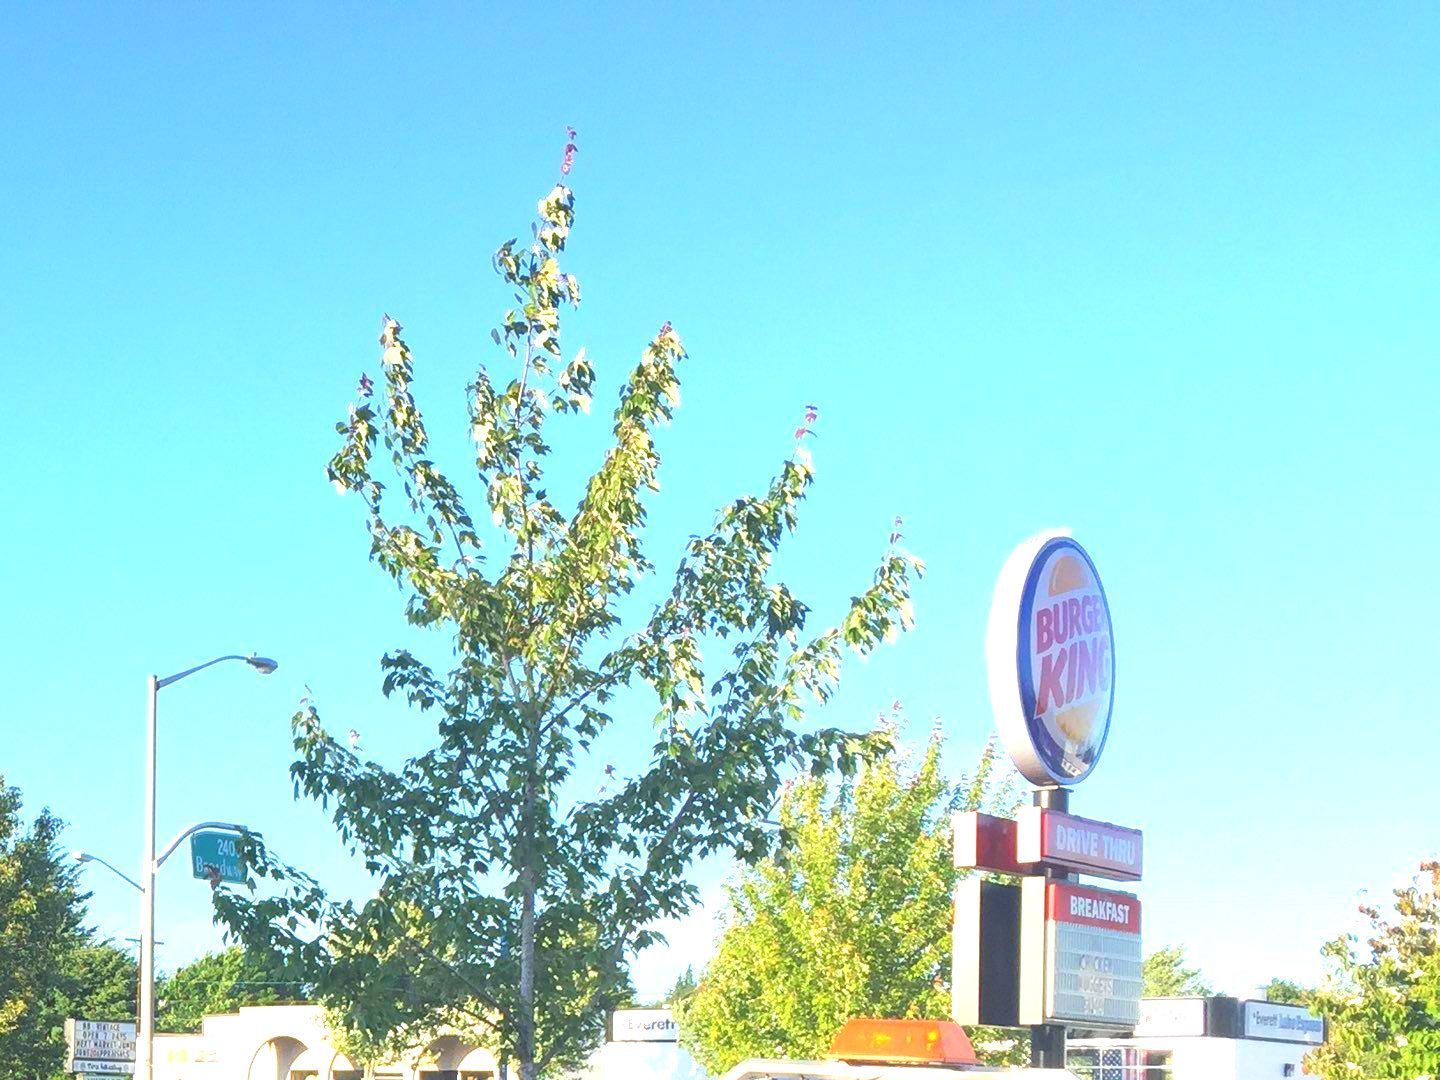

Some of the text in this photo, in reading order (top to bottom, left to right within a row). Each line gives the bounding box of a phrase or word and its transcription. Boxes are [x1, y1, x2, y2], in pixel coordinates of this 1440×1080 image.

[1036, 636, 1110, 717] KING
[217, 838, 241, 858] 240
[1057, 824, 1135, 865] DRIVE THRU
[1070, 895, 1130, 924] BREAKFAST
[83, 1031, 99, 1040] OPEN
